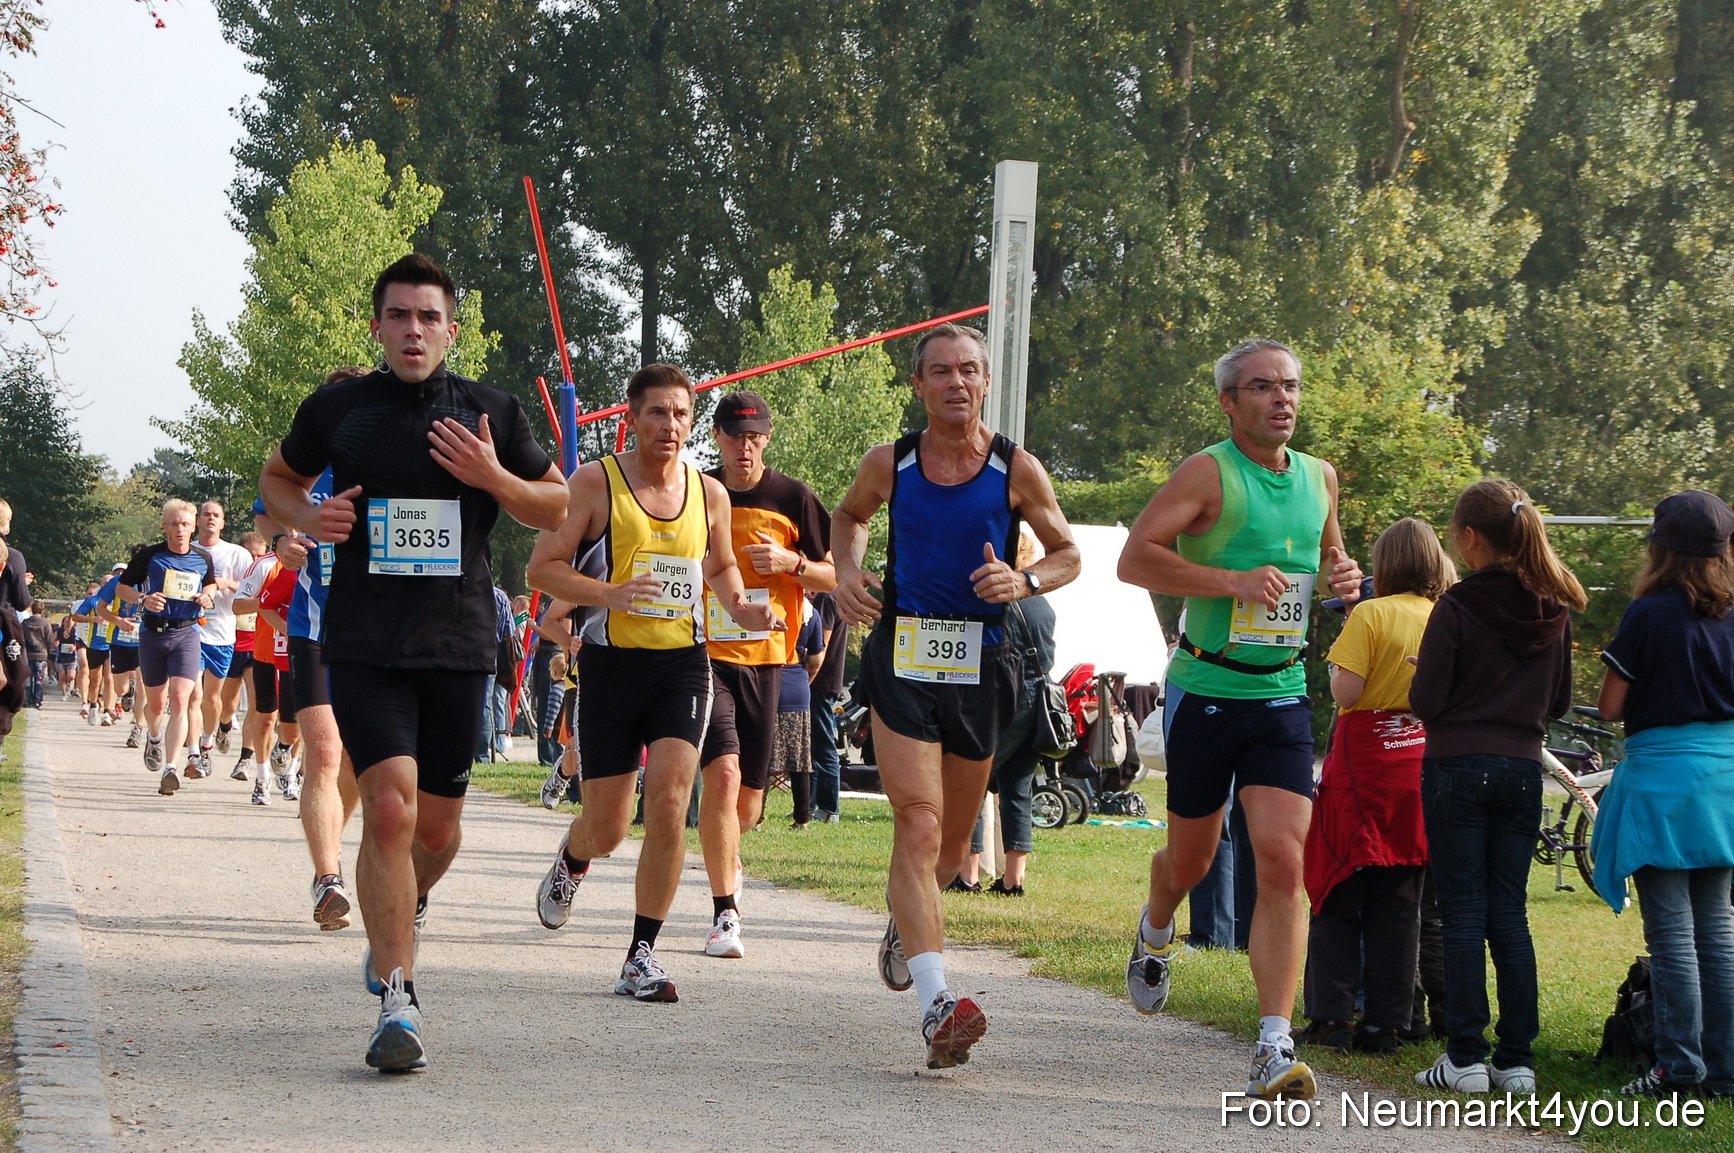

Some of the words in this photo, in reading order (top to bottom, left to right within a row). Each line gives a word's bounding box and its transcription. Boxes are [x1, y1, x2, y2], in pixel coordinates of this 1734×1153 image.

[394, 506, 427, 520] Jonas
[374, 527, 379, 537] A
[394, 528, 450, 548] 3635
[653, 560, 687, 577] Jürgen
[178, 582, 194, 592] 139
[921, 618, 966, 633] Gerhard
[899, 635, 905, 646] B
[927, 639, 967, 660] 398
